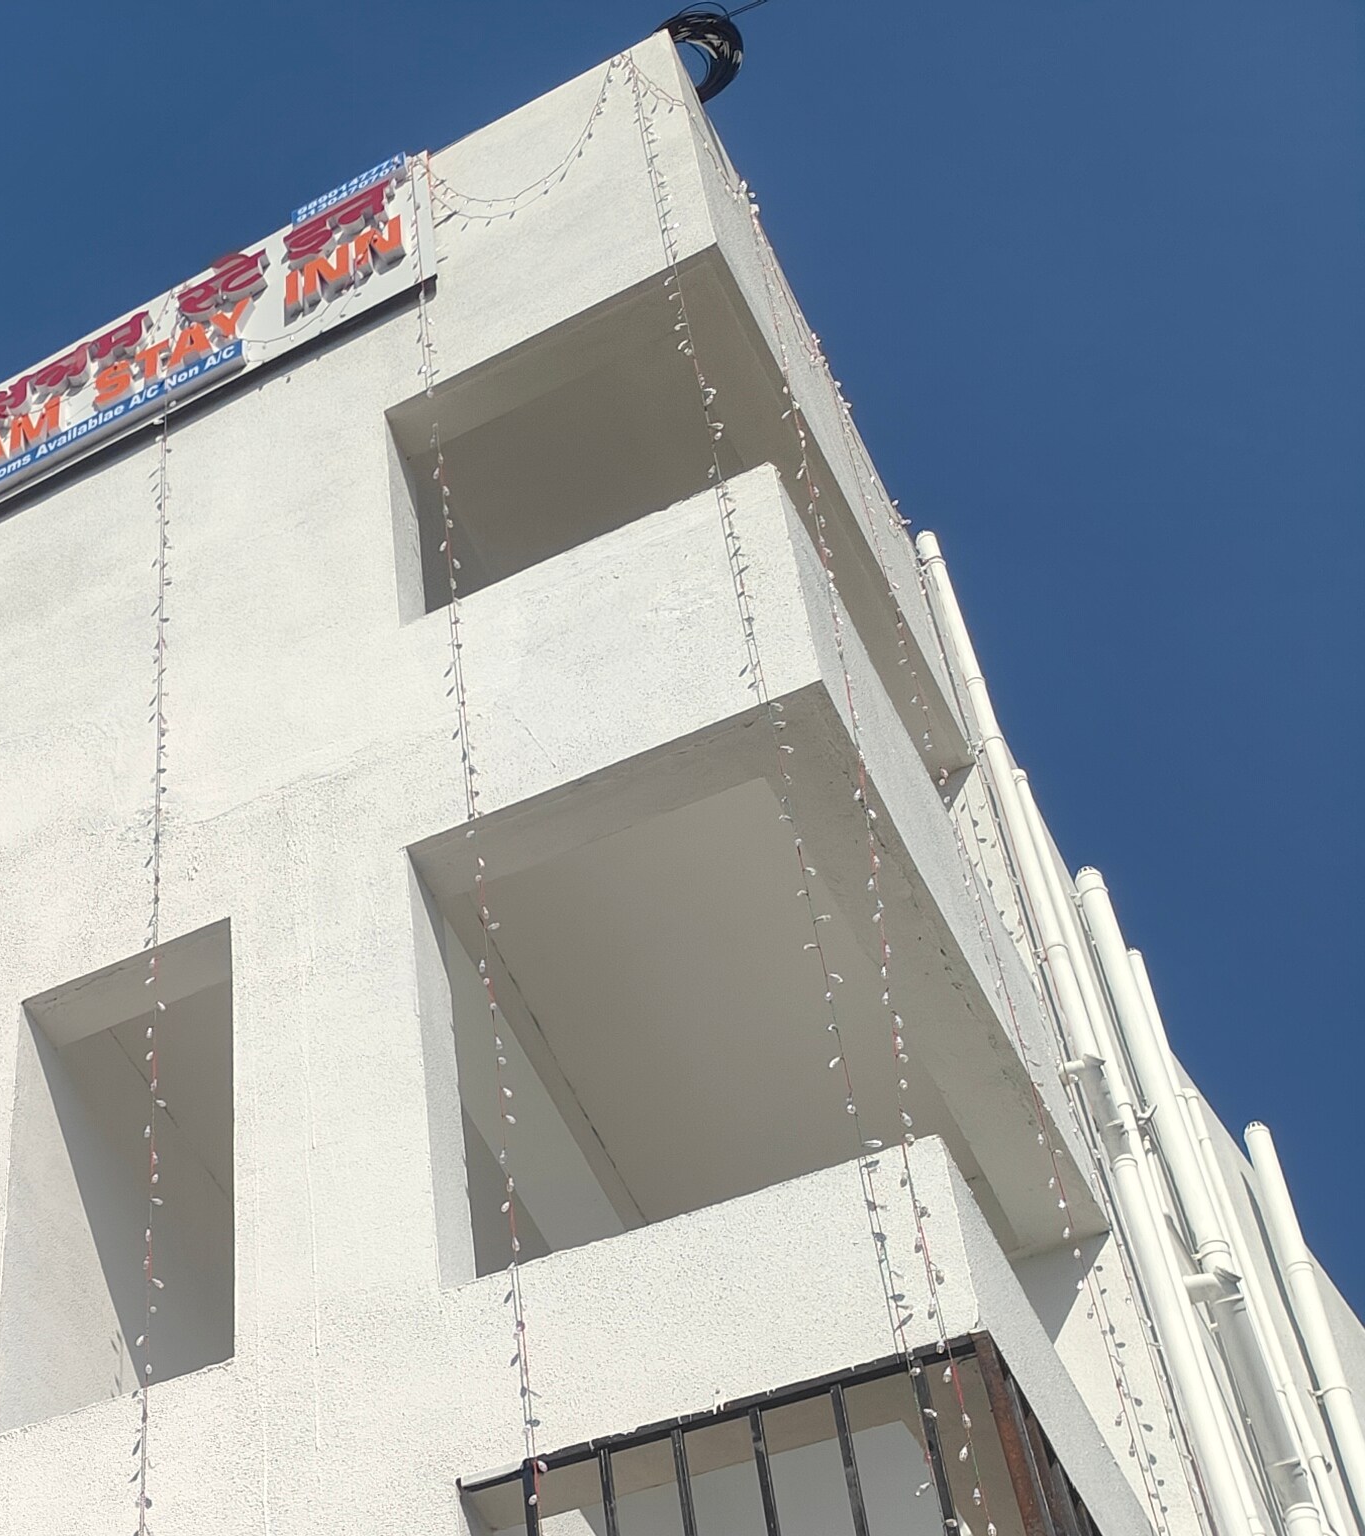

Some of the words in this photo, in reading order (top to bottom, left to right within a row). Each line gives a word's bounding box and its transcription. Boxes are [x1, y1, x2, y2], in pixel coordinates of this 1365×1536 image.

[94, 294, 252, 405] STAY
[285, 213, 402, 306] INN
[128, 384, 159, 408] A/C
[165, 368, 199, 390] Non
[203, 345, 235, 366] A/C
